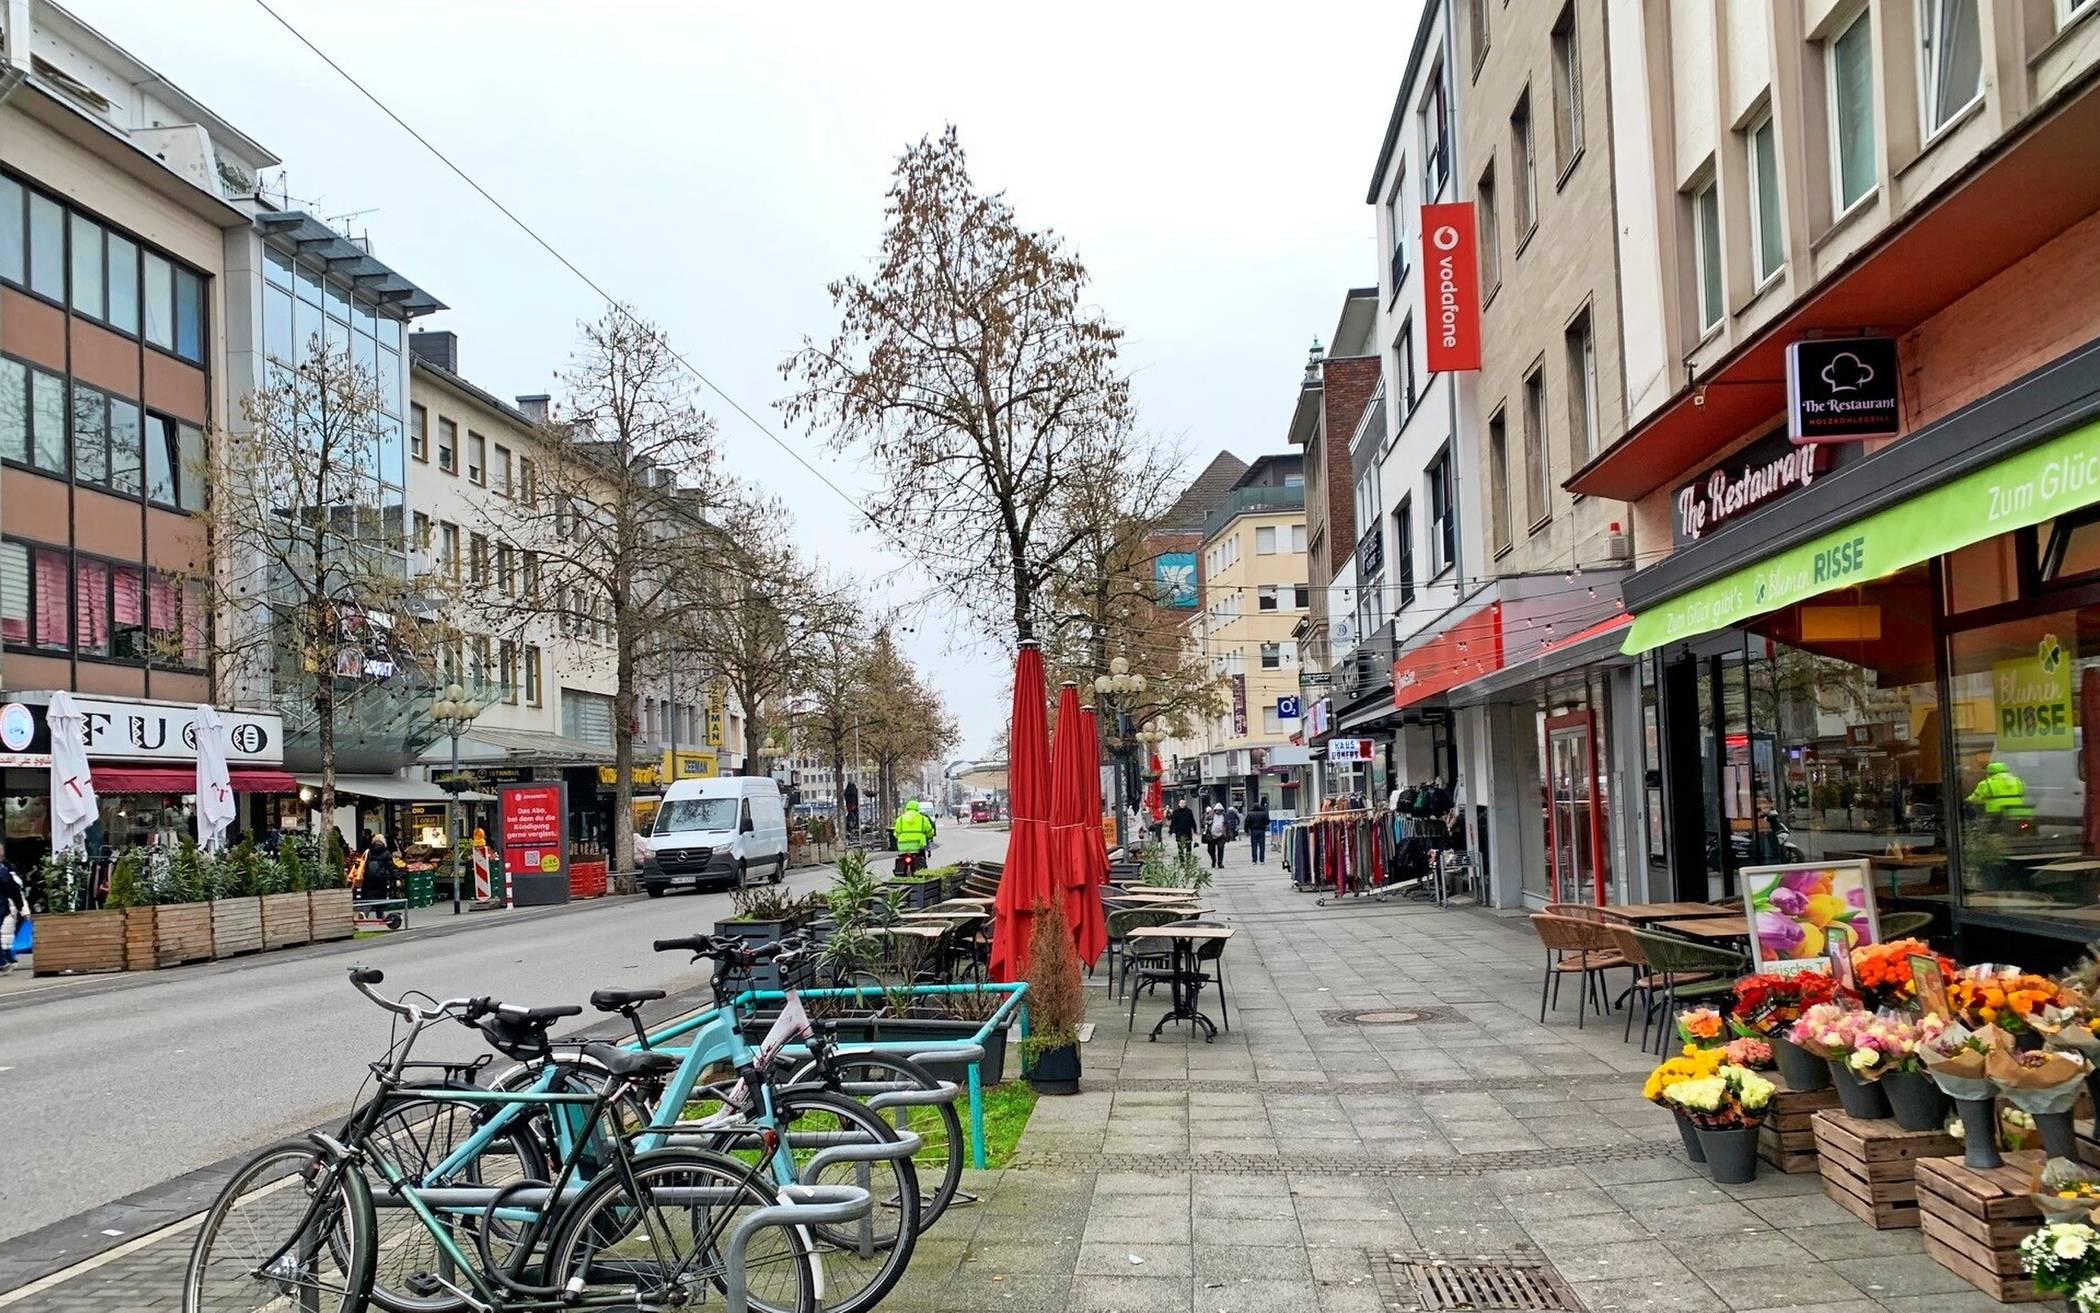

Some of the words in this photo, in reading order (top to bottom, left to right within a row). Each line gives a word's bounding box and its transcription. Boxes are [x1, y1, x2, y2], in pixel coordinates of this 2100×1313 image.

[1440, 255, 1460, 348] vodafone
[1802, 400, 1825, 413] The
[1826, 398, 1895, 413] Restaurant
[1679, 483, 1706, 540] The
[1707, 442, 1818, 521] Restaurant
[1988, 481, 2034, 520] Zum
[1814, 537, 1865, 584] RISSE
[2000, 669, 2064, 704] Blumen
[2002, 704, 2065, 738] RISSE
[684, 760, 709, 773] ZEEMAN
[507, 832, 527, 840] gerne
[513, 823, 550, 831] Kündigung
